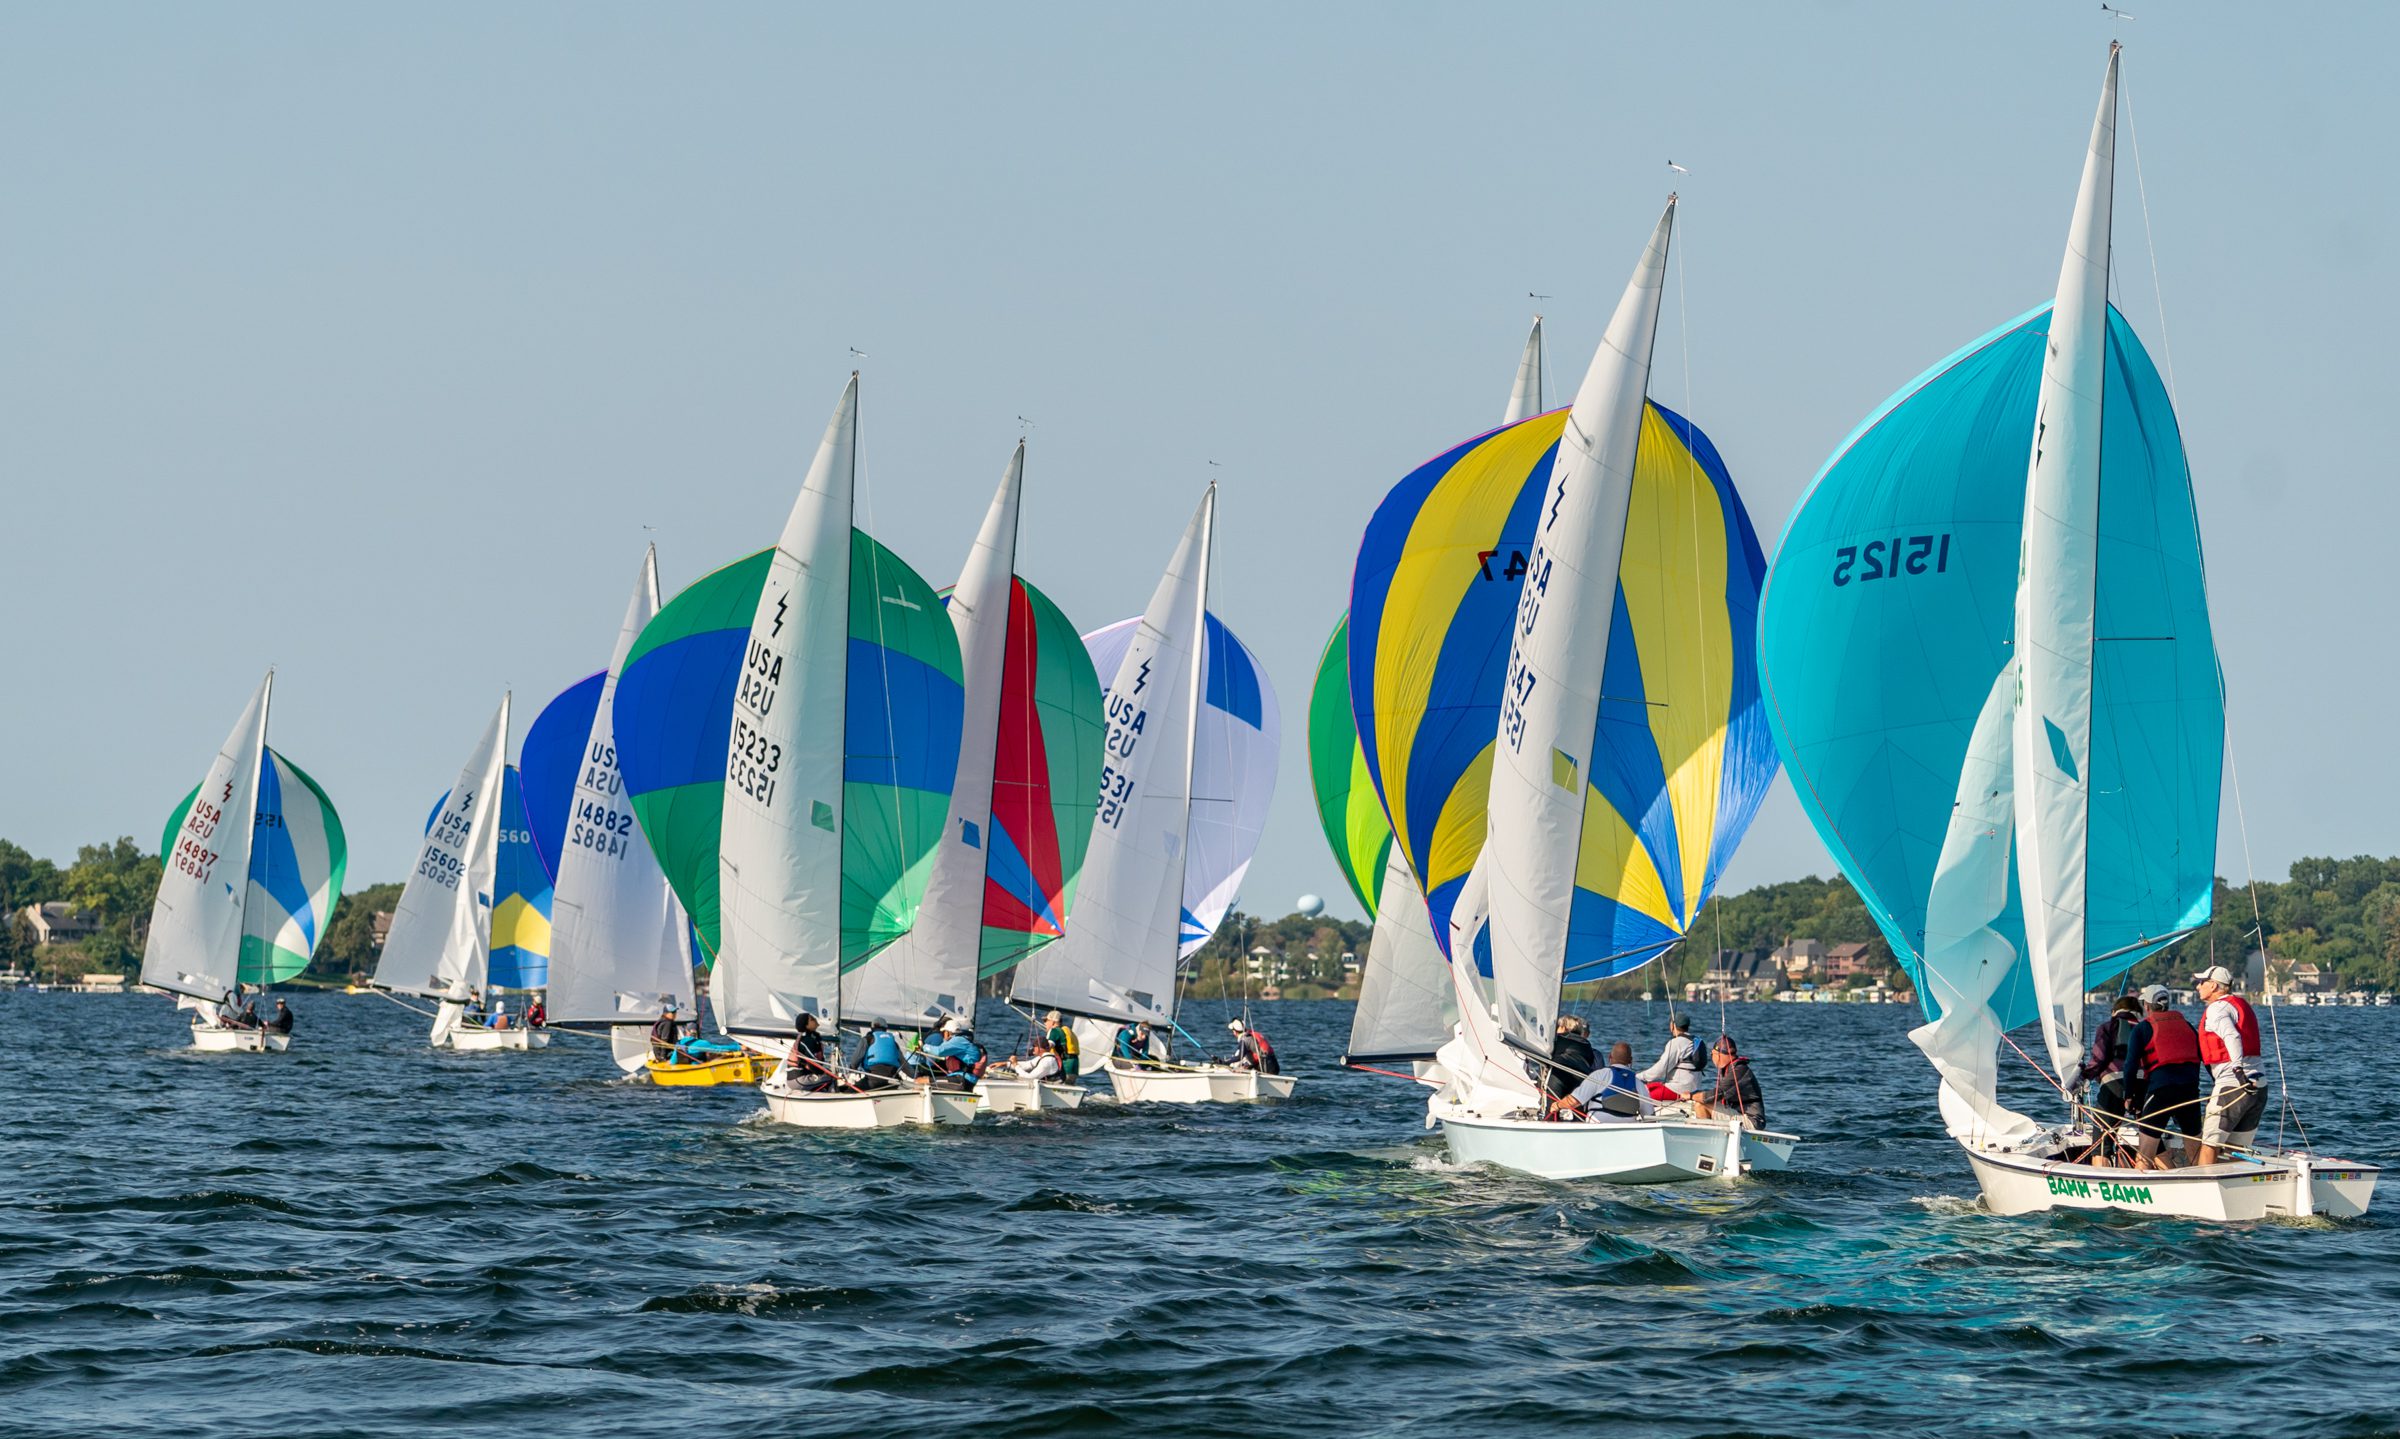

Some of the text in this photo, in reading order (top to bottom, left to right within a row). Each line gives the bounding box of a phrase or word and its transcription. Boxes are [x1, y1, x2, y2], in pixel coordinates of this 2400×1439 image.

[749, 639, 783, 686] USA
[1109, 694, 1147, 735] USA
[592, 742, 620, 771] US
[733, 717, 781, 773] 15233
[196, 799, 221, 826] USA
[442, 810, 472, 836] USA
[577, 798, 633, 837] 14882
[179, 836, 219, 867] 14897
[425, 845, 466, 877] 15602
[2046, 1175, 2154, 1205] BAMM-BAMM
